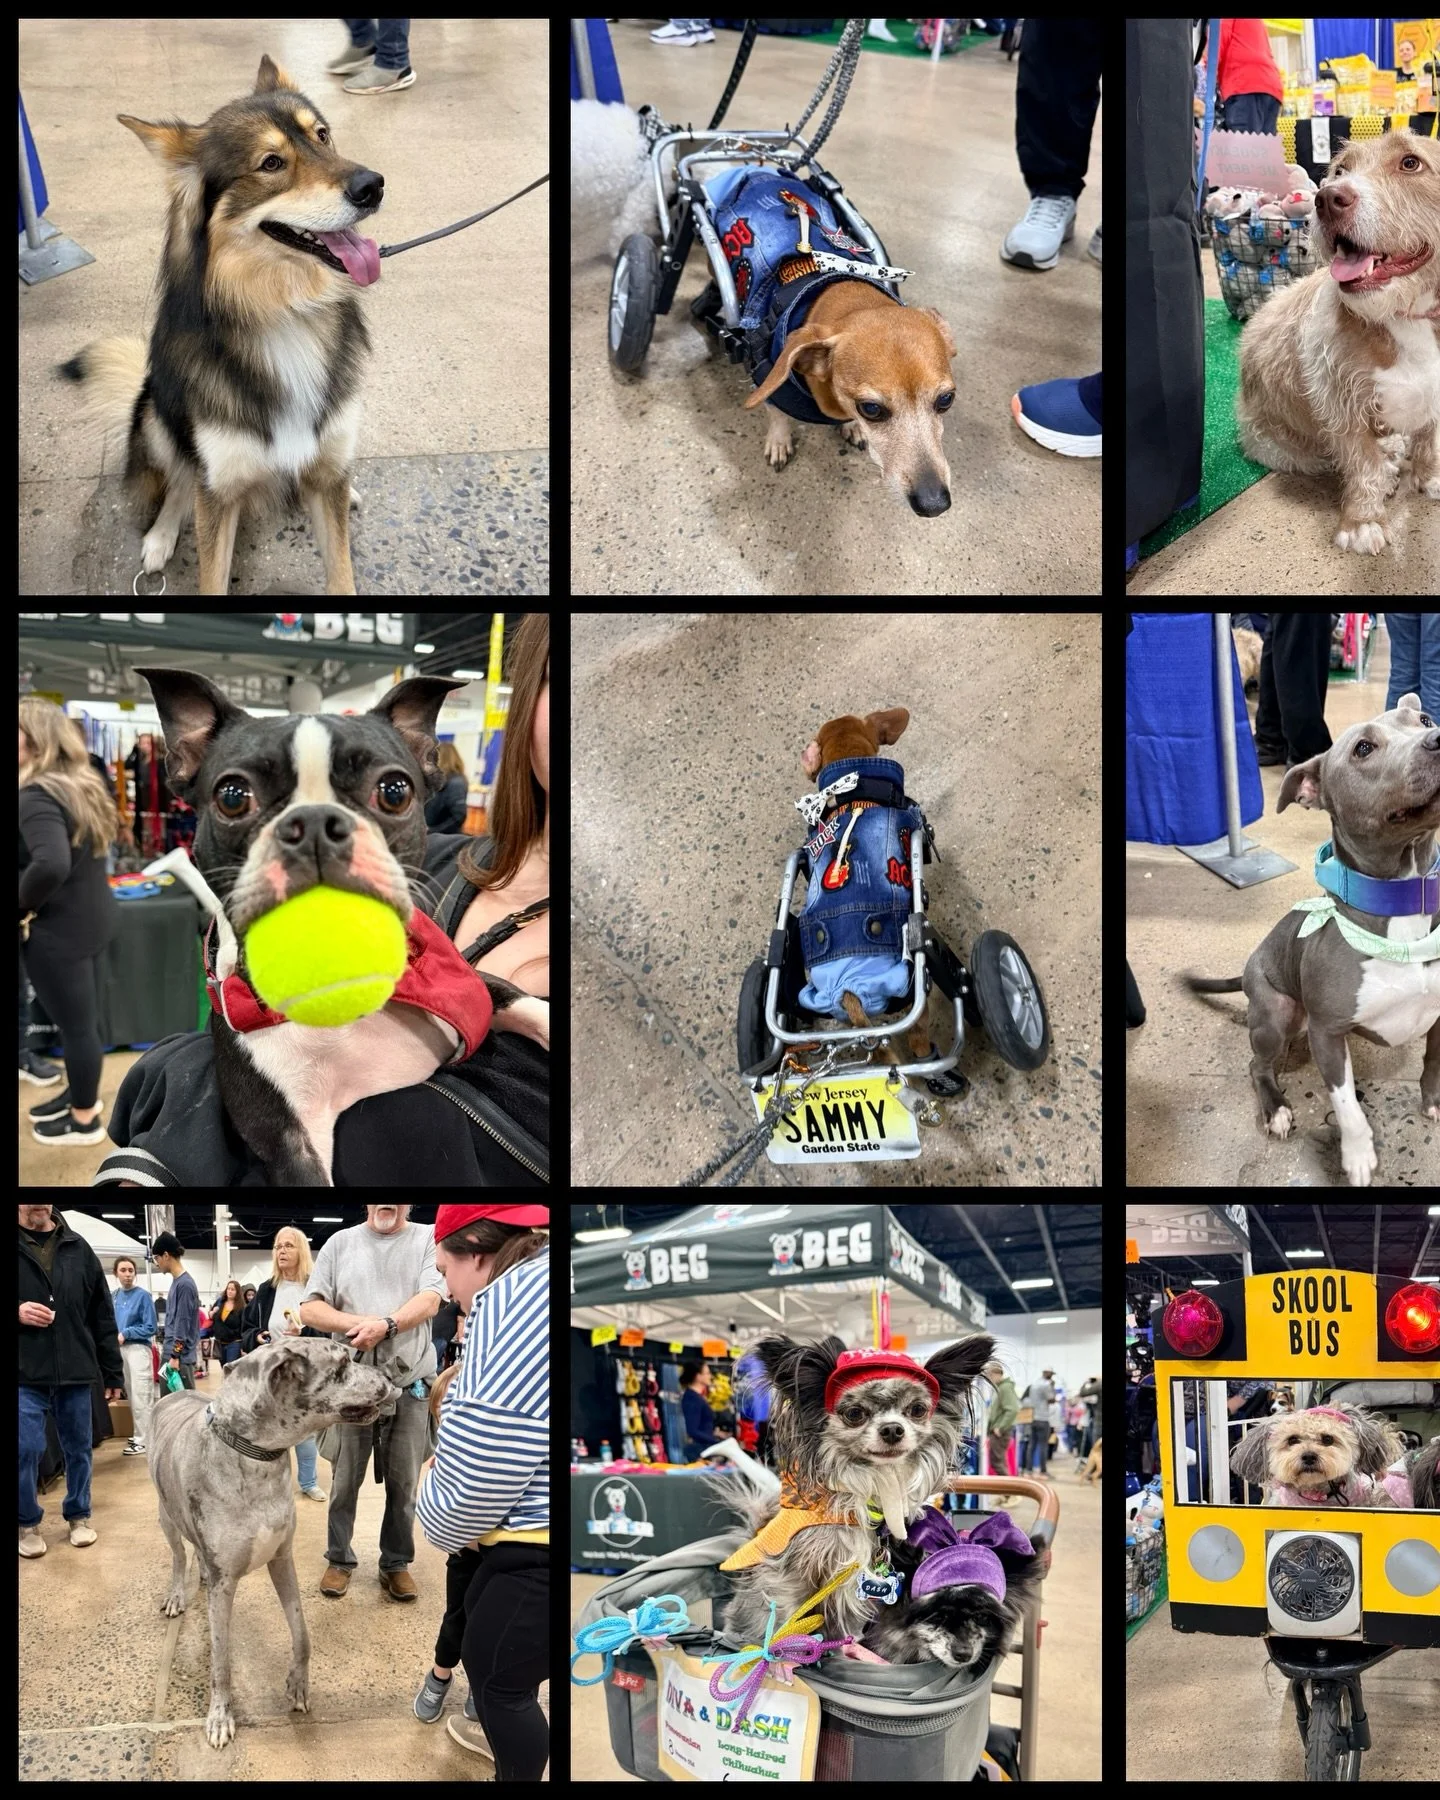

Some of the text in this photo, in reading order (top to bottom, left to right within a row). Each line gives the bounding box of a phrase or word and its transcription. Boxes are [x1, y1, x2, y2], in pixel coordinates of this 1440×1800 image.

[824, 1087, 868, 1103] Jersey
[781, 1100, 886, 1143] SAMMY
[802, 1142, 881, 1154] Garden State
[802, 1222, 872, 1270] BEG
[651, 1243, 710, 1285] BEG
[1272, 1275, 1352, 1313] SKOOL
[1289, 1319, 1340, 1357] BUS
[699, 1705, 711, 1723] &
[717, 1738, 786, 1764] Long-Haired
[722, 1756, 780, 1780] Chihuahua
